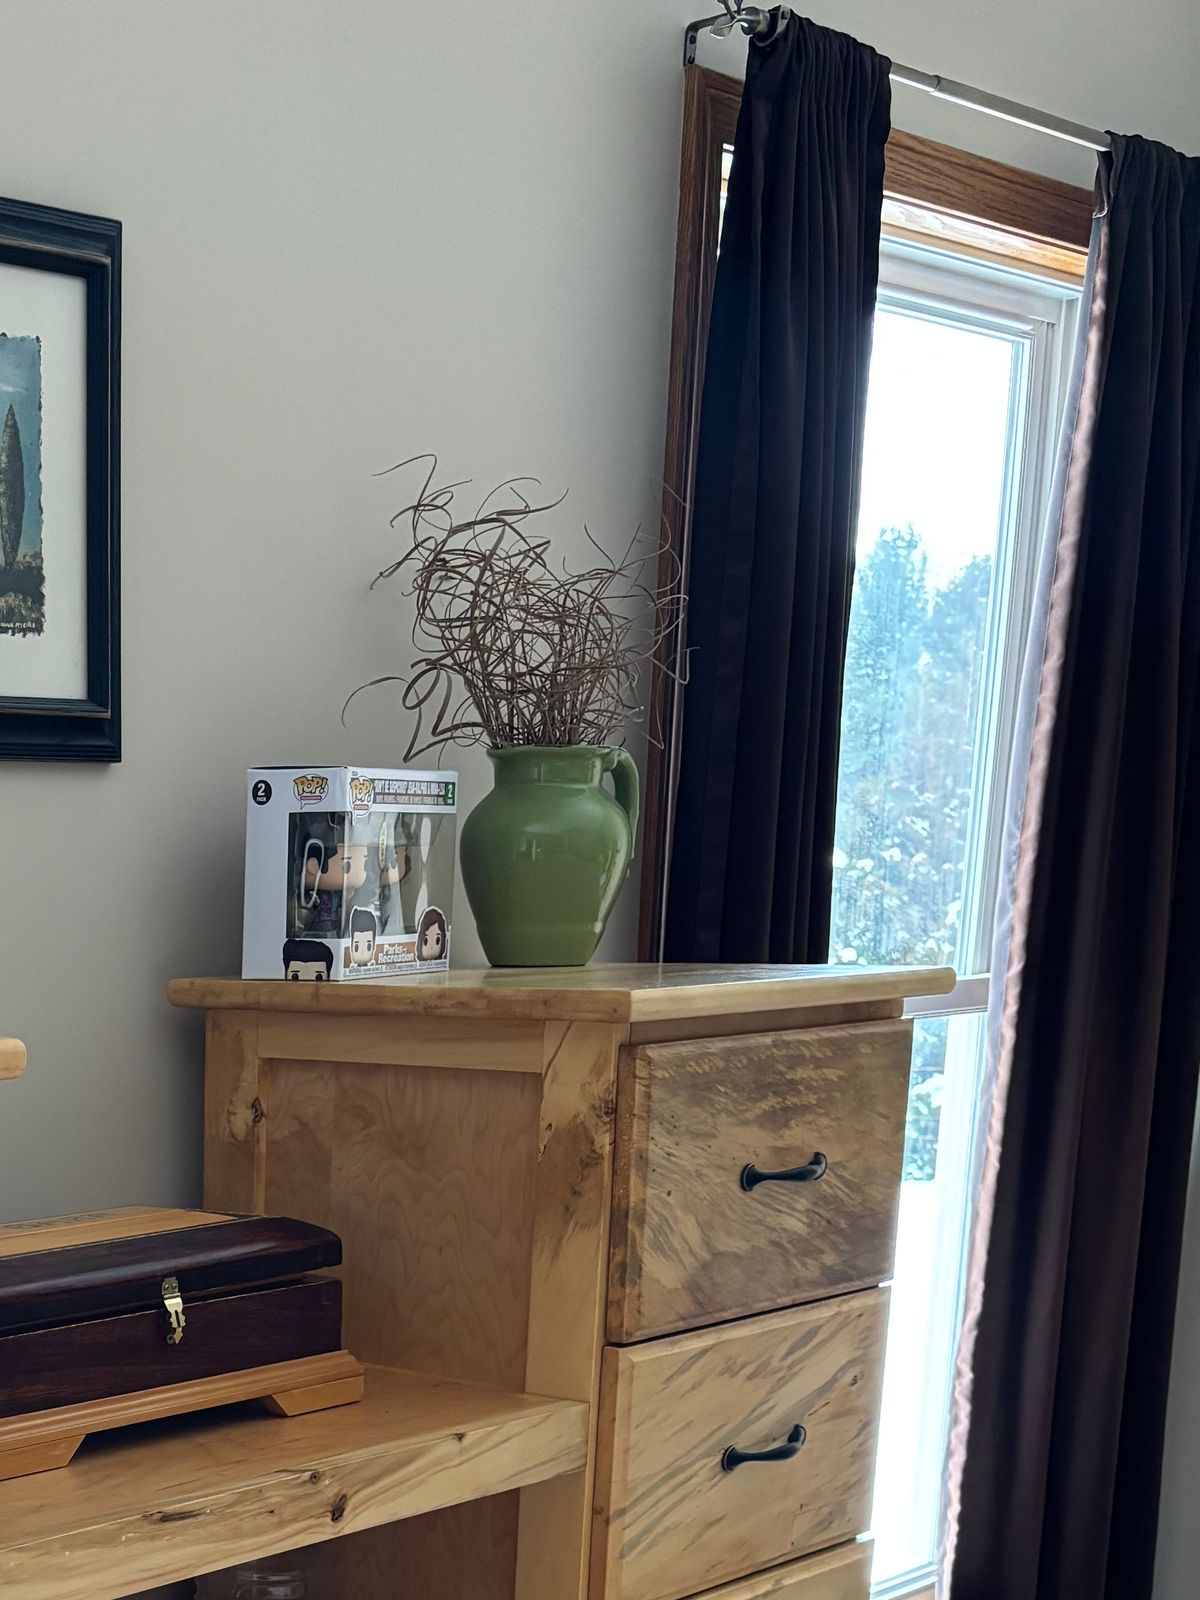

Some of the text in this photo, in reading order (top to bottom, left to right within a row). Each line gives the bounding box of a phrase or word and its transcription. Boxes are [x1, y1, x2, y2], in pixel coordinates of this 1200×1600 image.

[257, 783, 266, 796] 2
[293, 775, 328, 797] POP!
[349, 778, 373, 803] POP!
[447, 784, 453, 798] 2
